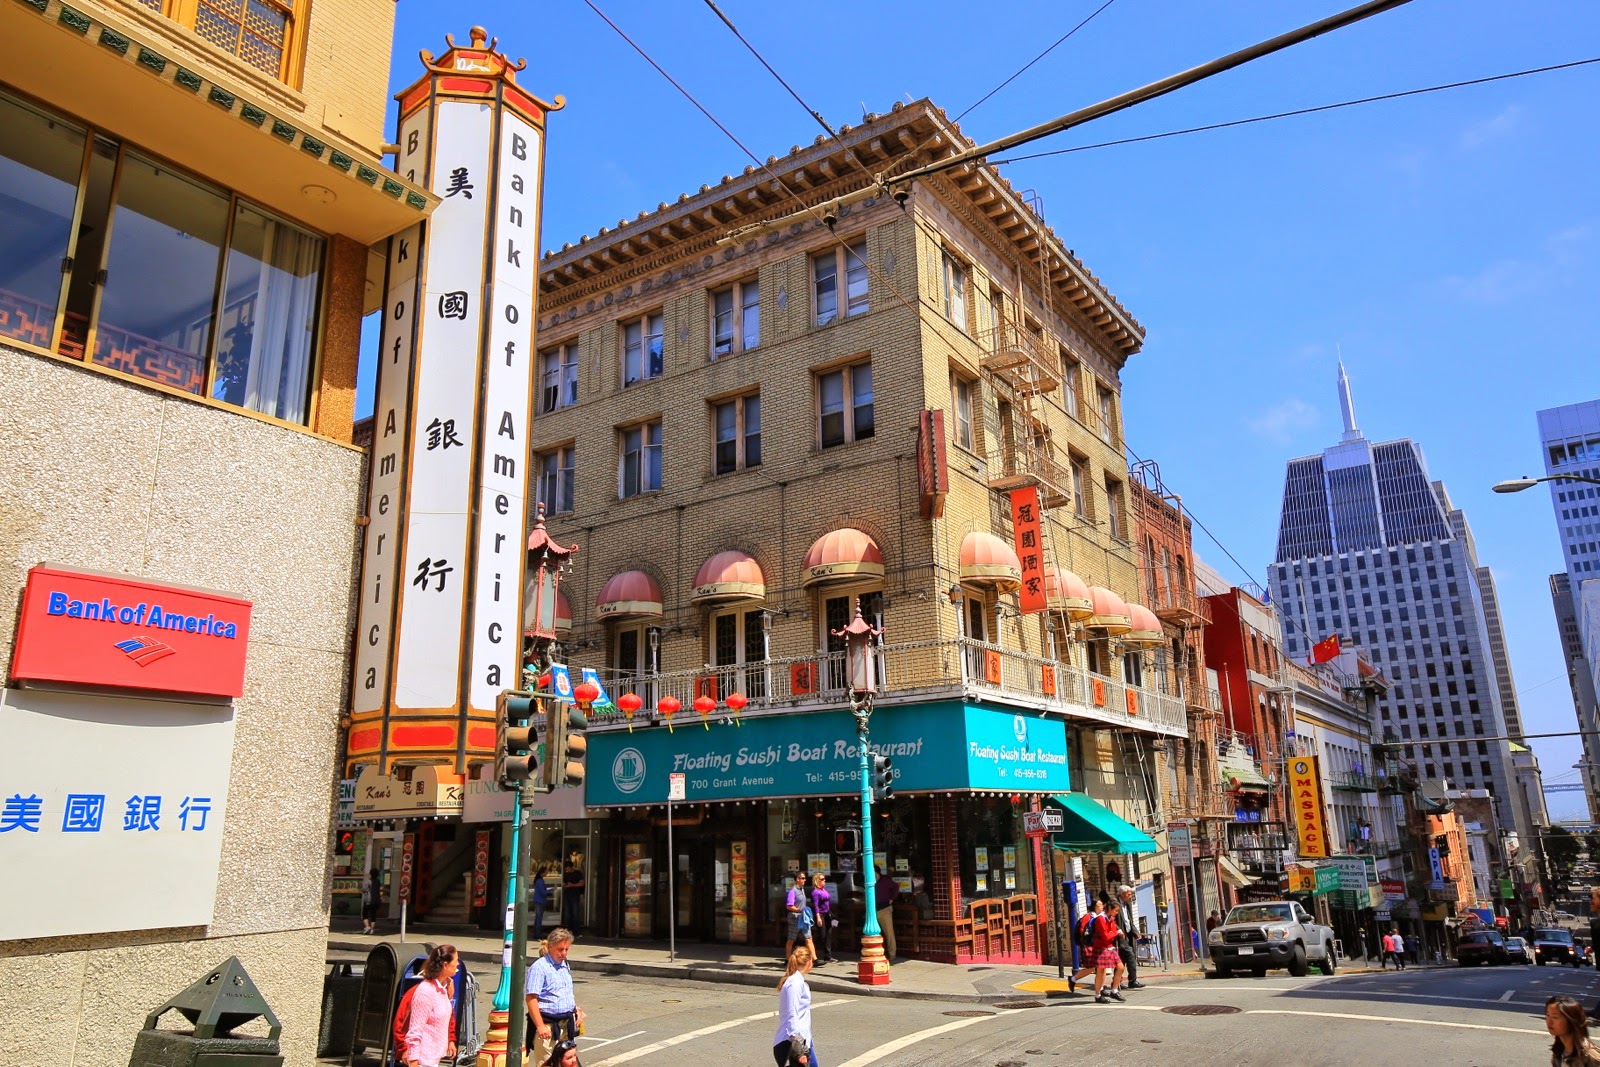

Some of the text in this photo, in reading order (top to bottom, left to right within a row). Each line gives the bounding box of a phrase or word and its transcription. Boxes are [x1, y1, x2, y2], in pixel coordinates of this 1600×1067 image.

[413, 167, 474, 592] 美國銀行
[364, 129, 419, 690] Bak of America
[486, 132, 527, 687] Bank of America
[697, 586, 717, 596] Kan's
[47, 590, 237, 640] Bank of America
[673, 752, 731, 772] Floating
[736, 745, 781, 767] Sushi
[786, 742, 828, 762] Boat
[969, 741, 1066, 765] Floating Sushi Boat Restaurant
[691, 779, 708, 789] 700
[713, 777, 737, 788] Grant
[742, 775, 775, 786] Avenue
[806, 772, 823, 783] Tel:
[829, 768, 902, 782] 415-95-18
[998, 767, 1008, 777] Tel:
[365, 786, 392, 799] Kan's
[0, 793, 211, 833] 美國銀行
[1296, 779, 1319, 853] MASSAGE
[1431, 849, 1441, 880] CPA
